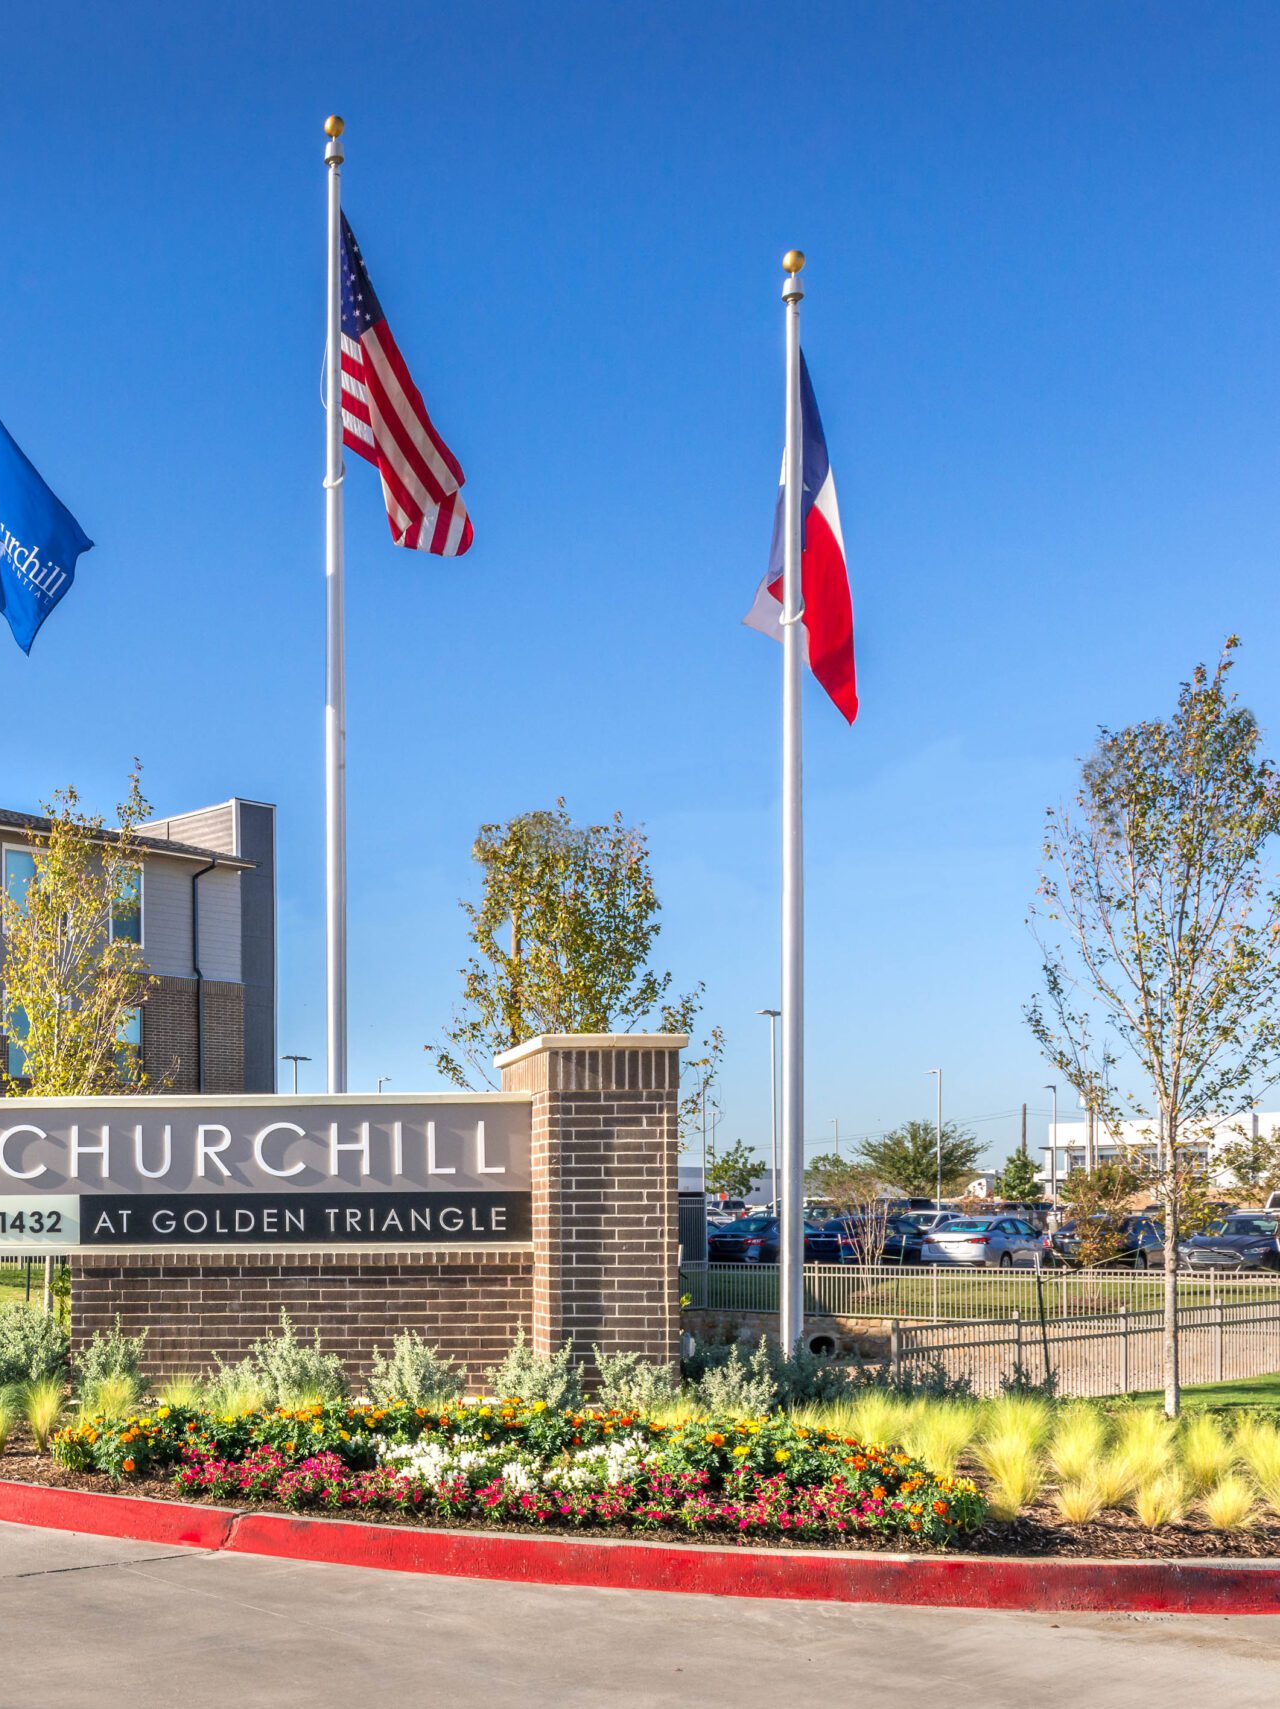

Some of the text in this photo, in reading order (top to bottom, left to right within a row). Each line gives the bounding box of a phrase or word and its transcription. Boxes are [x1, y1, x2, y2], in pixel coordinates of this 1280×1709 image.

[93, 1207, 507, 1234] AT GOLDEN TRIANGLE
